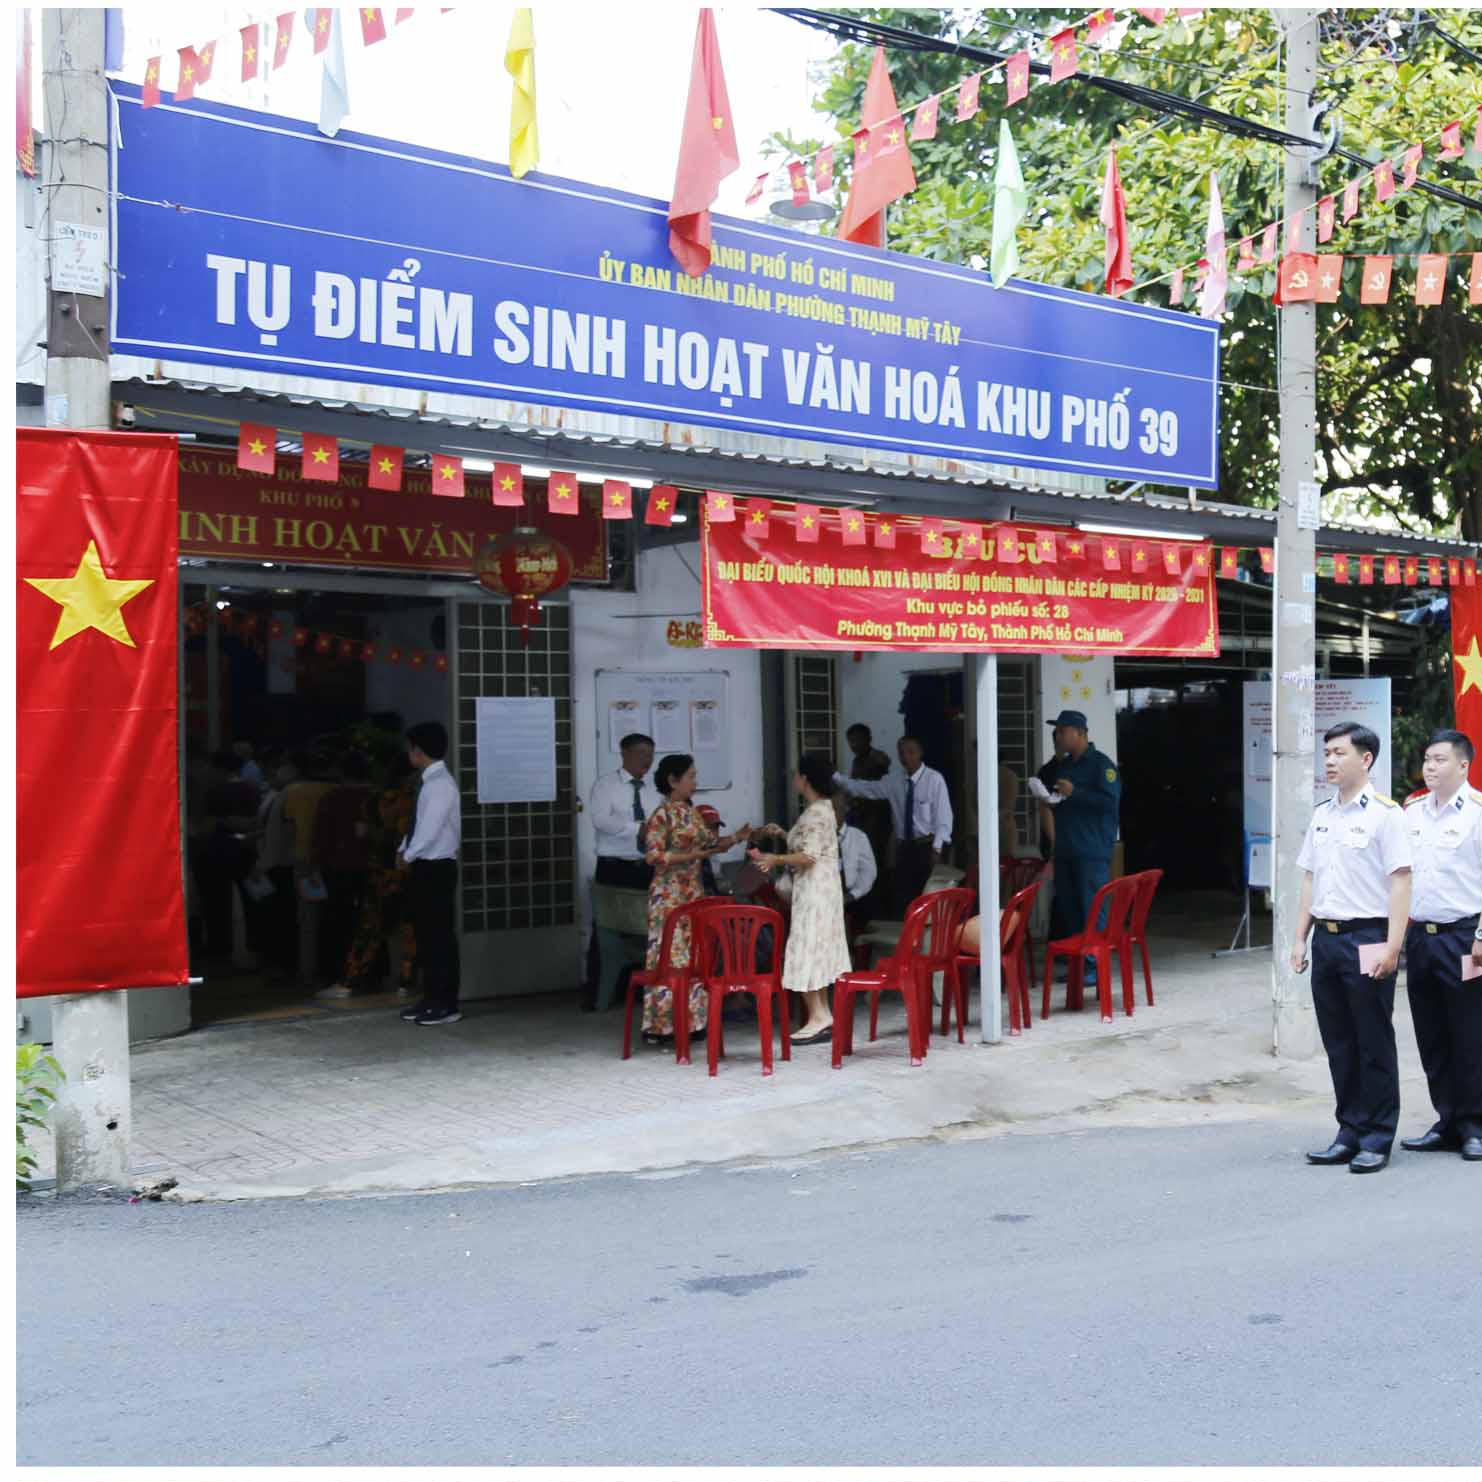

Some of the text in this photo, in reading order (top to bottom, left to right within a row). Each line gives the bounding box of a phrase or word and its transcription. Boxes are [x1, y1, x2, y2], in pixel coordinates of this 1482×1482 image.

[599, 250, 961, 345] ỦY BAN NHÂN DÂN PHƯỜNG THẠNH MỸ TÂY
[751, 251, 894, 302] PHỐ CHÍ MINH
[206, 253, 1178, 457] TỤ ĐIỂM SINH HOẠT VĂN HOÁ KHU PHỐ 39
[275, 517, 476, 559] HOẠT VĂN
[718, 556, 1108, 600] ĐẠI BIỂU QUỐC HỘI KHOÁ XVI VÀ CÁC CẤP
[906, 598, 1069, 619] Khu vực bỏ phiếu số: 28
[837, 619, 1123, 643] Phường Thạnh Mỹ Tây, Thành Phố Chí Minh
